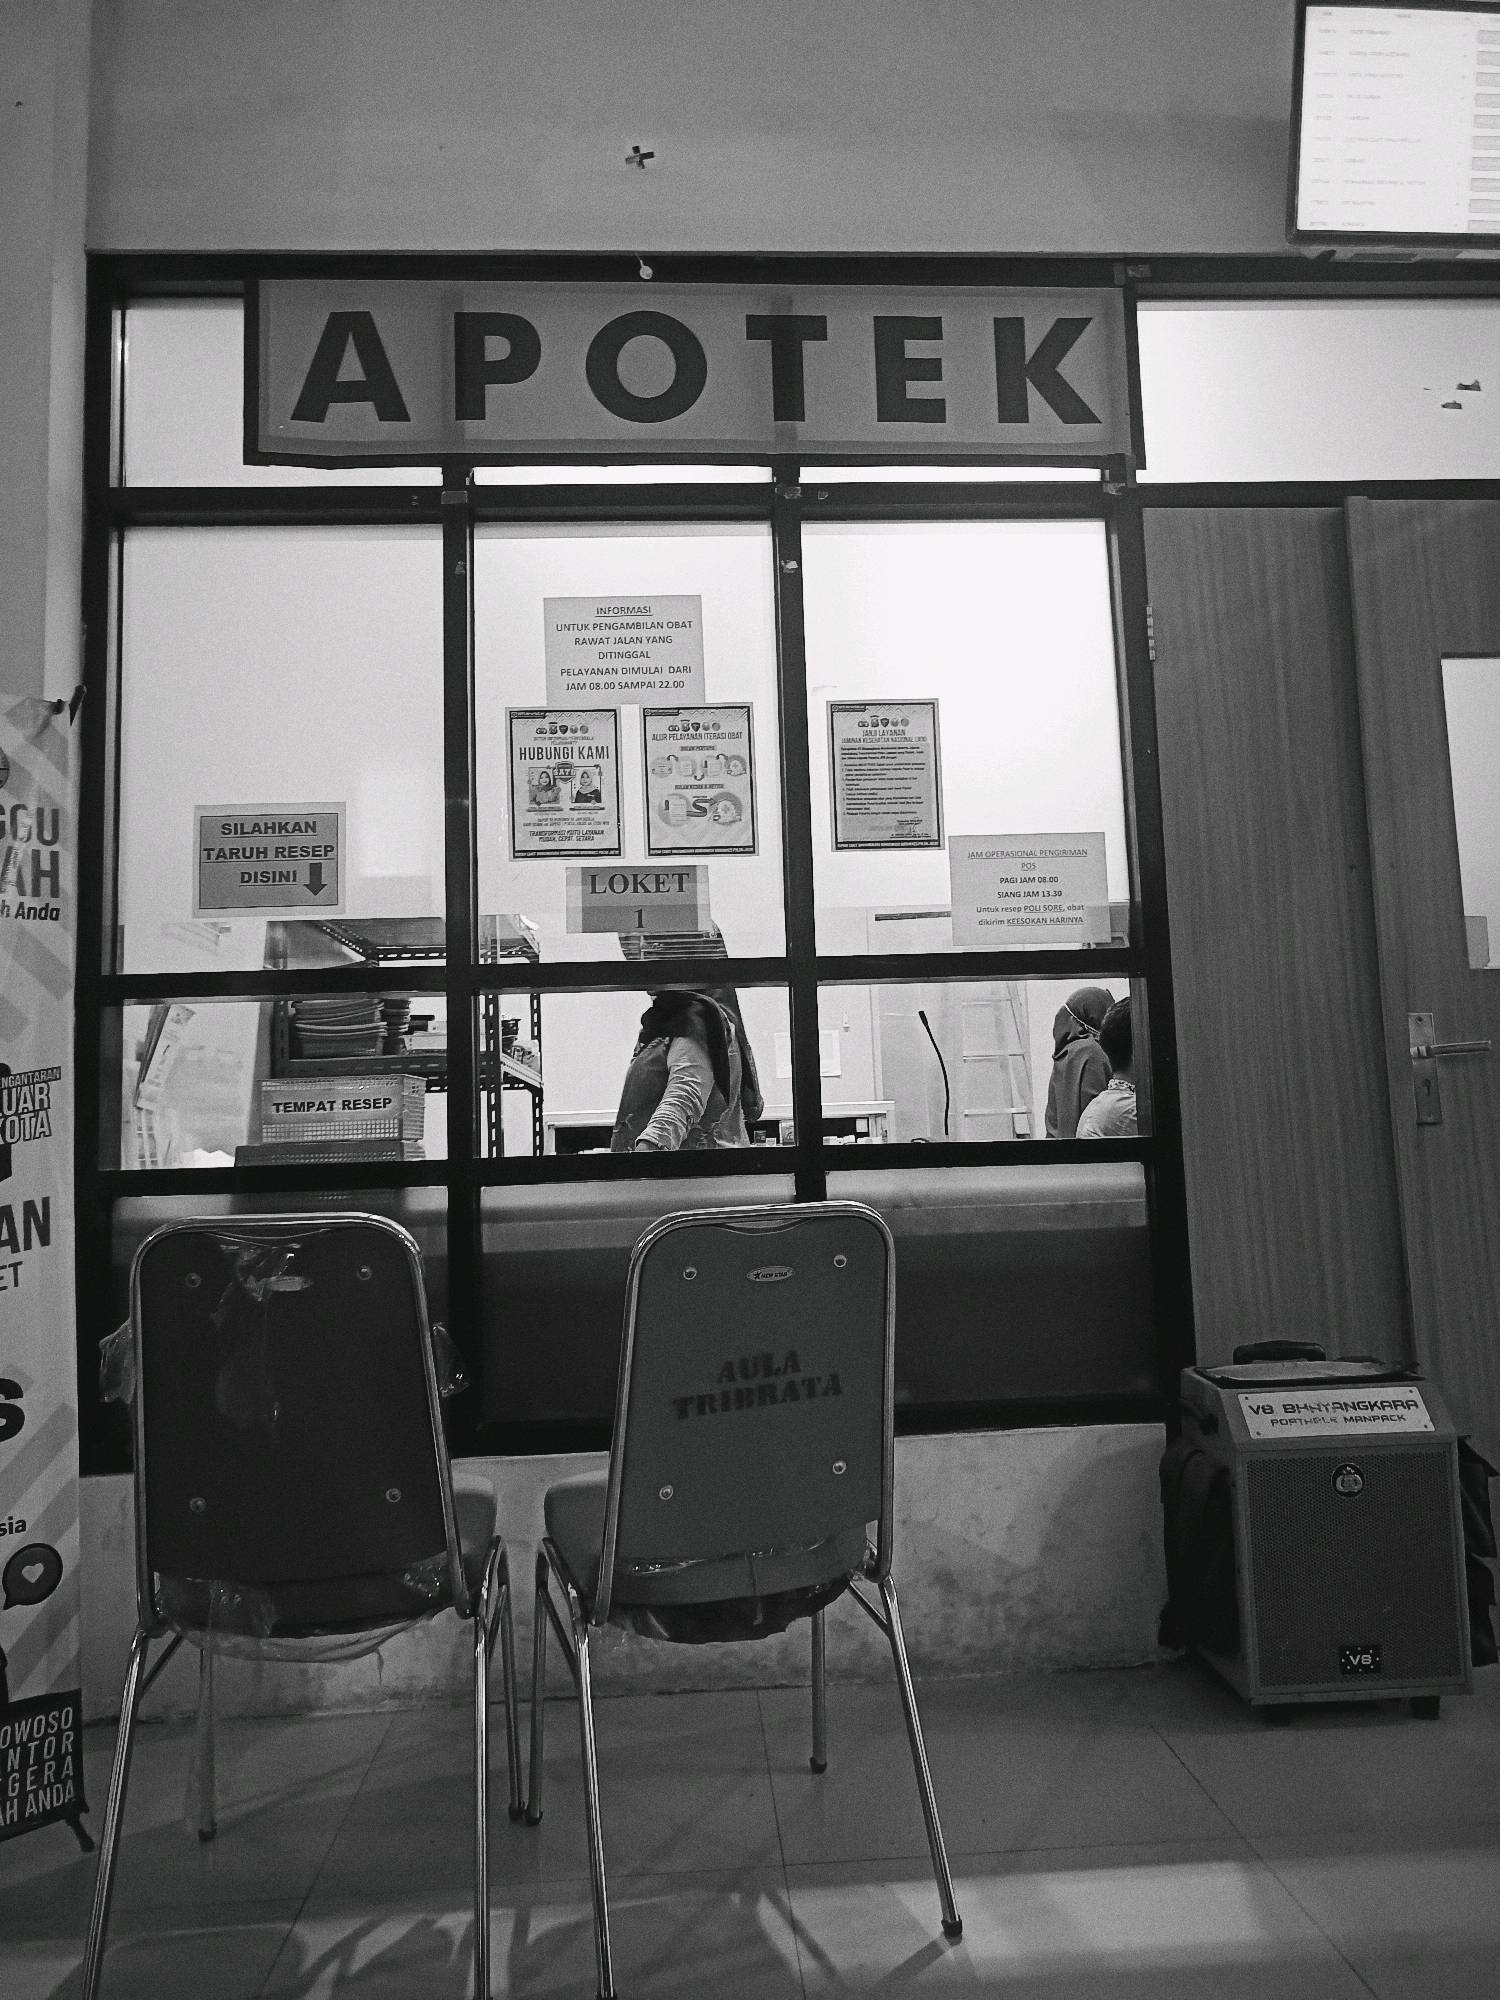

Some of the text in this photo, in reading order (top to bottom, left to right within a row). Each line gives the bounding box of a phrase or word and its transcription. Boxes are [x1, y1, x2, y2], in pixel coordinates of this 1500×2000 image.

[290, 310, 1102, 425] APOTEK
[596, 606, 651, 615] INFORMASI
[556, 620, 693, 632] UNTUK PENGAMBILAN OBAT
[574, 635, 673, 645] RAWAT JALAN YANG
[598, 650, 651, 660] DITINGGAL
[560, 665, 692, 676] PELAYANAN DIMULAI DARI
[566, 680, 685, 691] JAM 08.00 SAMPAI 22.00
[668, 733, 703, 741] PELAYANAN
[703, 732, 726, 740] ITERASI
[727, 731, 743, 740] OBAT
[878, 729, 906, 737] LAYANAN
[519, 745, 610, 760] HUBUNGI KAMI
[0, 804, 59, 847] GU
[220, 820, 317, 836] SILAHKAN
[203, 845, 335, 860] TARUH RESEP
[967, 849, 1088, 859] JAM OPERASIONAL PENGIRIMAN
[1021, 862, 1036, 870] POS
[240, 870, 297, 883] DISINI
[588, 872, 690, 894] LOKET
[1019, 876, 1036, 884] JAM
[14, 901, 60, 921] Anda
[1001, 906, 1022, 914] resep
[1043, 904, 1066, 912] SORE,
[634, 908, 645, 929] 1
[978, 916, 1084, 926] dikirim KEESOKAN HARINYA
[0, 1082, 50, 1117] UAR
[272, 1097, 393, 1113] TEMPAT RESEP
[0, 1196, 51, 1255] AN
[717, 1350, 801, 1384] AULA
[1248, 1403, 1275, 1415] V8
[1344, 1414, 1406, 1424] MANPACK
[1349, 1654, 1372, 1666] V8
[0, 1707, 73, 1749] OWOSO
[7, 1731, 74, 1772] NTOR
[0, 1755, 74, 1798] GERA
[25, 1780, 75, 1818] ANDA
